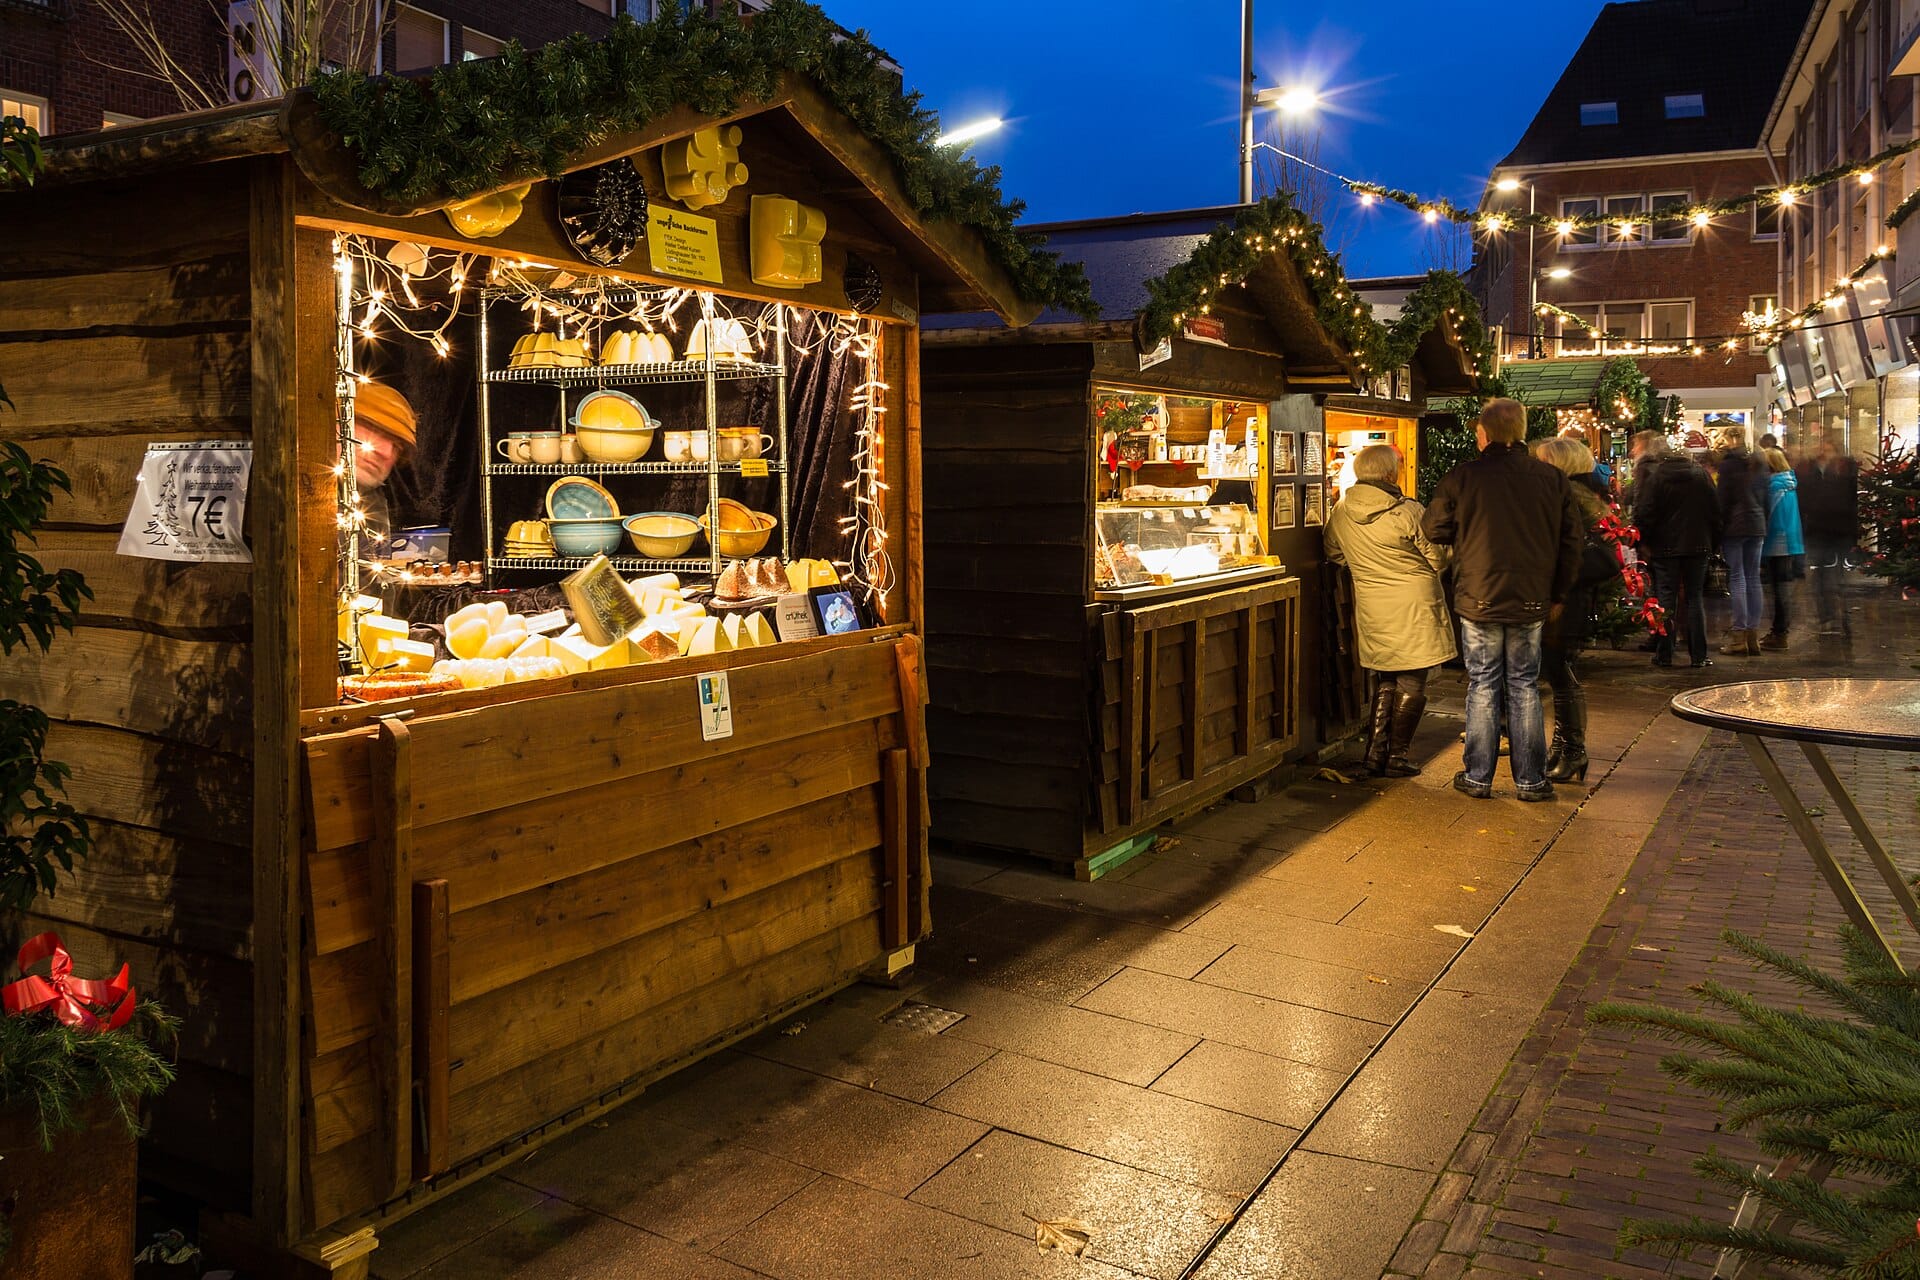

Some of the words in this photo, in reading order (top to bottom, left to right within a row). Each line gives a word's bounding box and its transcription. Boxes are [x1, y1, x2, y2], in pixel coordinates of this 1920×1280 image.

[183, 462, 193, 473] Wir
[194, 464, 222, 474] verkaufen
[222, 464, 241, 474] unsere
[187, 495, 227, 540] 7€
